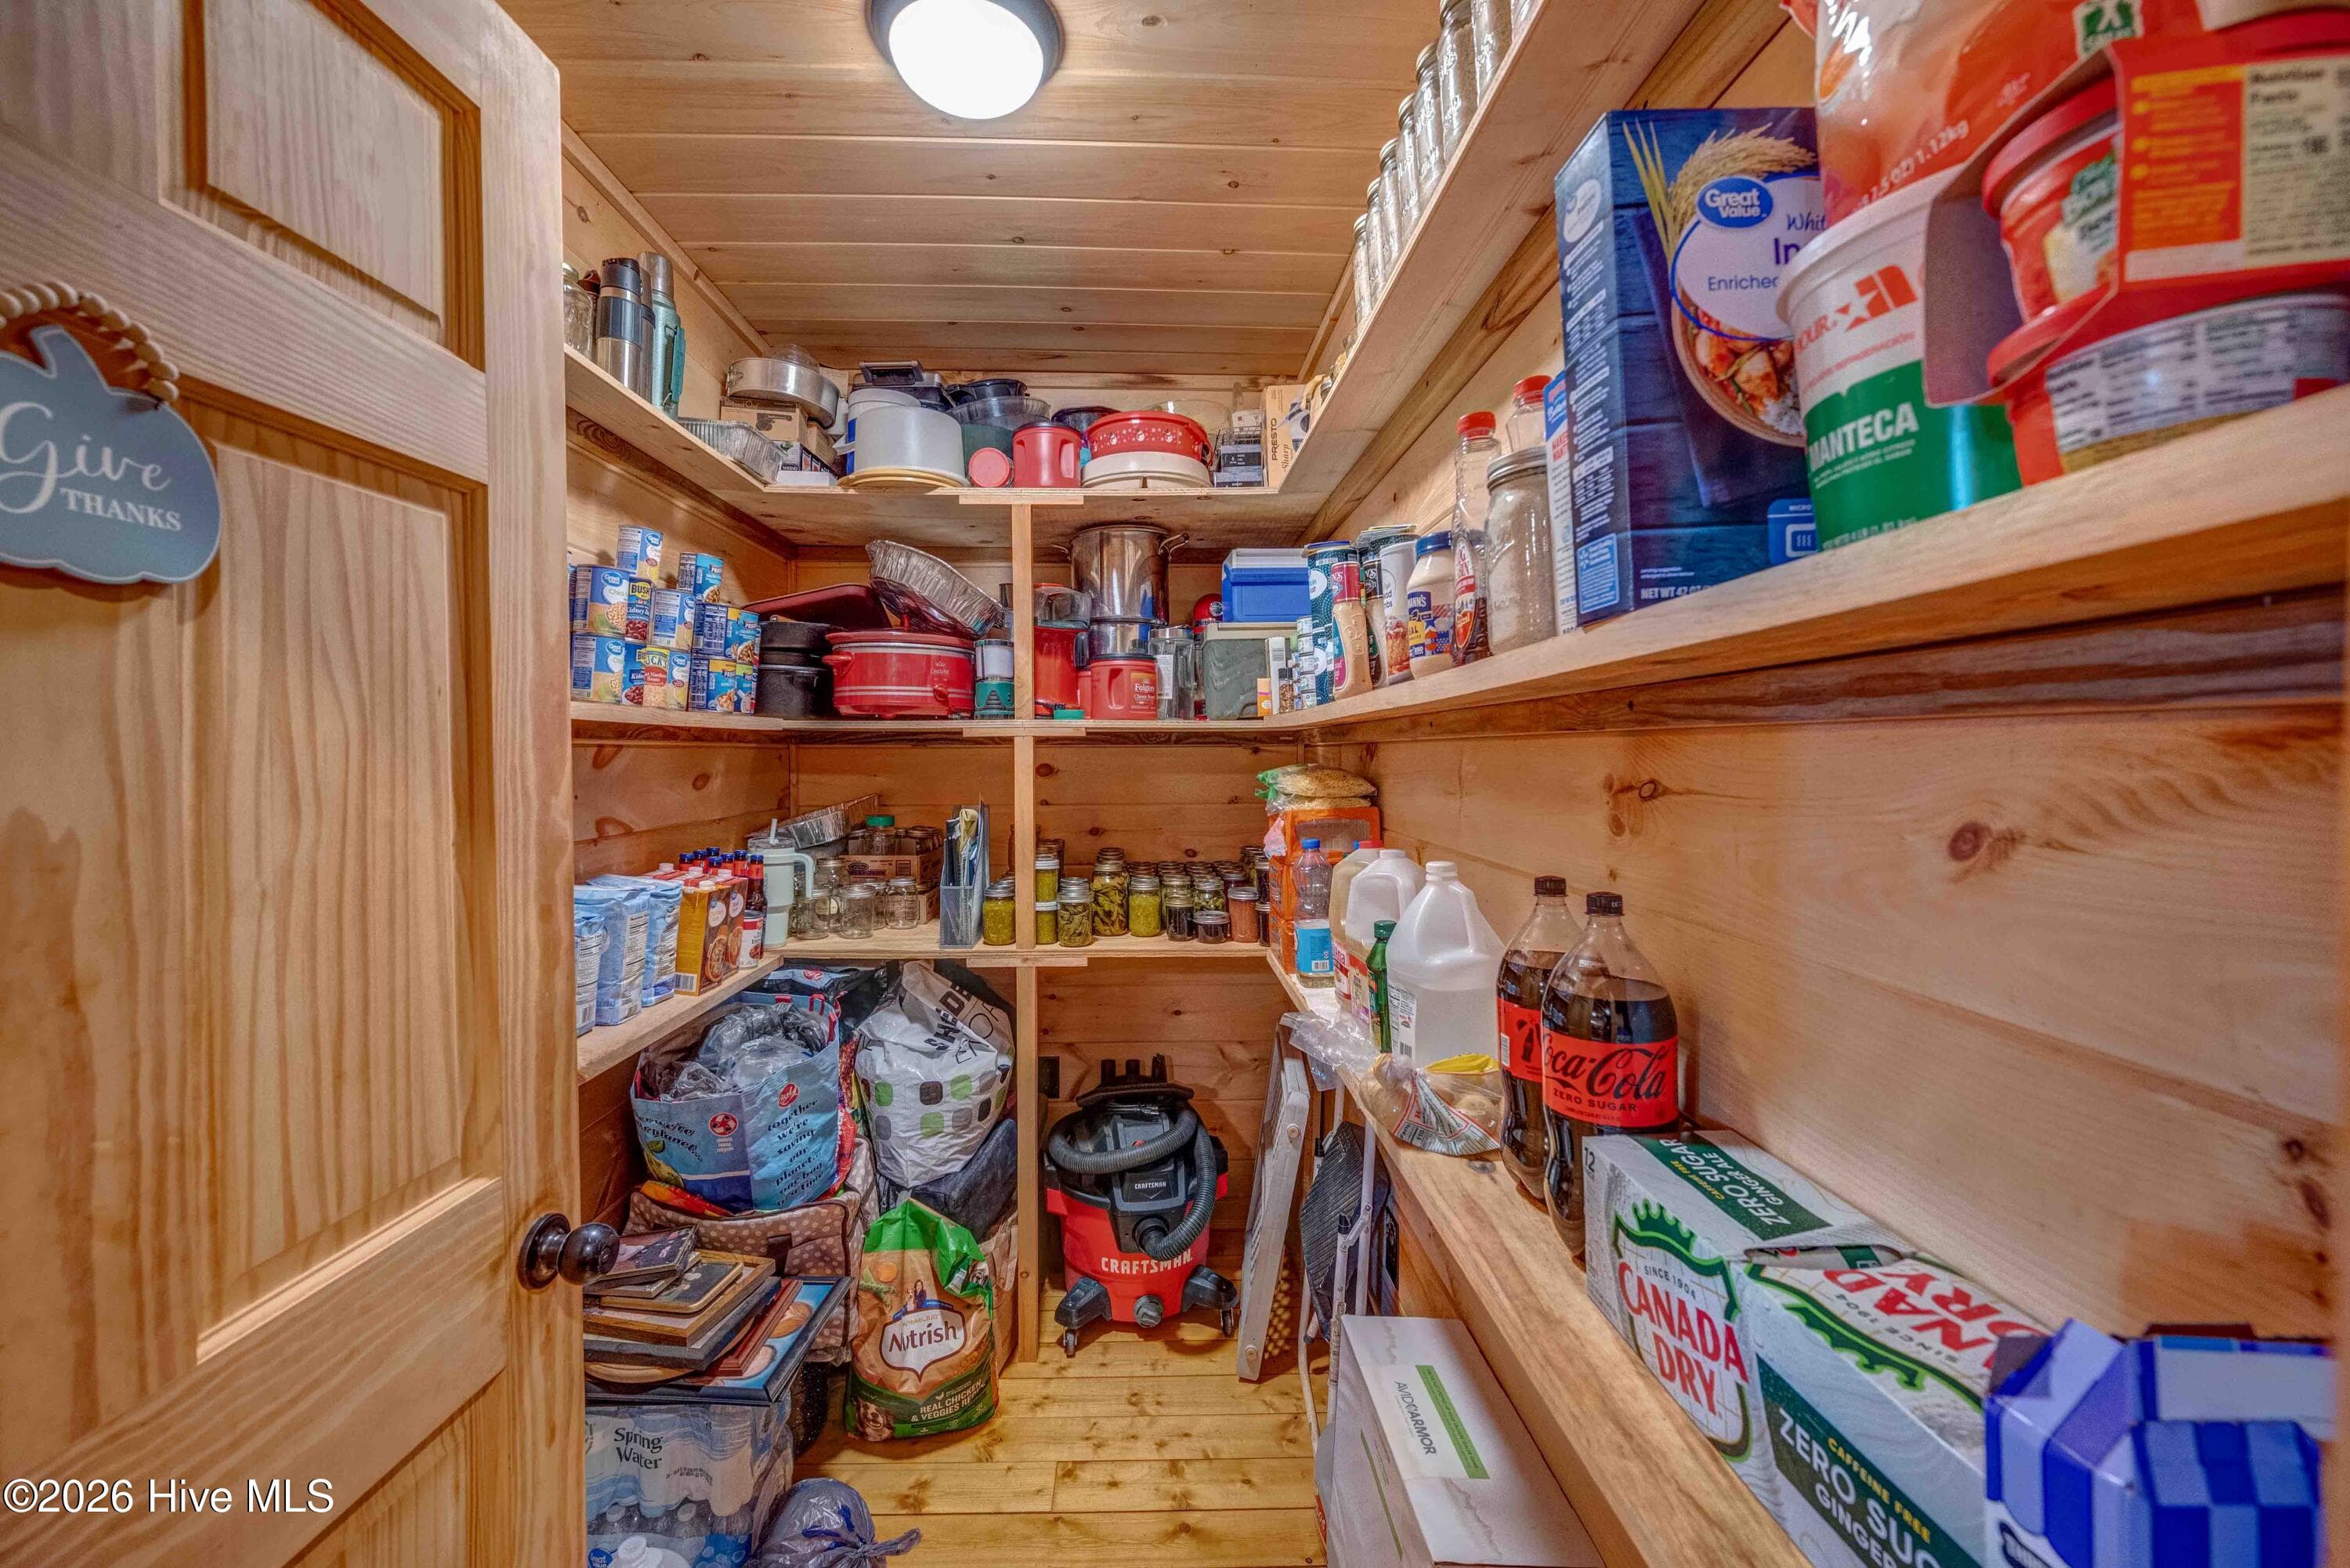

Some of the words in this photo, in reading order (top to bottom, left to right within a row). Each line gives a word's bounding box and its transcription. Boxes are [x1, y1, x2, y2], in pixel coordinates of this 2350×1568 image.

[1916, 119, 1970, 164] 1.12kg
[1705, 188, 1761, 208] Great
[1718, 205, 1762, 219] Value
[1787, 211, 1826, 232] Whit
[1773, 237, 1801, 265] In
[0, 402, 172, 514] Give
[1282, 443, 1292, 471] Sharp
[60, 487, 182, 531] THANKS
[1542, 1033, 1669, 1100] Coca-Cola
[1553, 1088, 1582, 1105] ZERO
[1588, 1099, 1638, 1111] SUGAR
[768, 1100, 818, 1132] together
[777, 1118, 808, 1140] we're
[777, 1129, 815, 1156] saving
[790, 1147, 808, 1163] our
[1584, 1147, 1596, 1173] 12
[1659, 1138, 1730, 1183] SUGAR
[1703, 1152, 1735, 1169] ALE
[779, 1176, 800, 1194] one
[1135, 1181, 1166, 1190] CRAFTSMAN
[1727, 1170, 1784, 1206] GINGER
[1723, 1184, 1791, 1226] ZERO
[1101, 1248, 1191, 1275] CRAFTSMAN
[1643, 1265, 1669, 1281] SINCE
[1672, 1275, 1697, 1300] 1904
[1618, 1261, 1749, 1384] CANADA
[1835, 1293, 1878, 1325] 1904
[888, 1321, 957, 1353] Nutrish
[1884, 1326, 1961, 1364] SINCE
[1653, 1331, 1718, 1416] DRY
[920, 1401, 943, 1414] REAL
[920, 1403, 960, 1421] VEGGIES
[613, 1427, 664, 1454] Spring
[616, 1447, 663, 1469] Water
[1779, 1407, 1856, 1505] ZERO
[1867, 1498, 1943, 1568] SU
[1828, 1436, 1890, 1505] CAFFEINE
[1894, 1500, 1931, 1545] FREE
